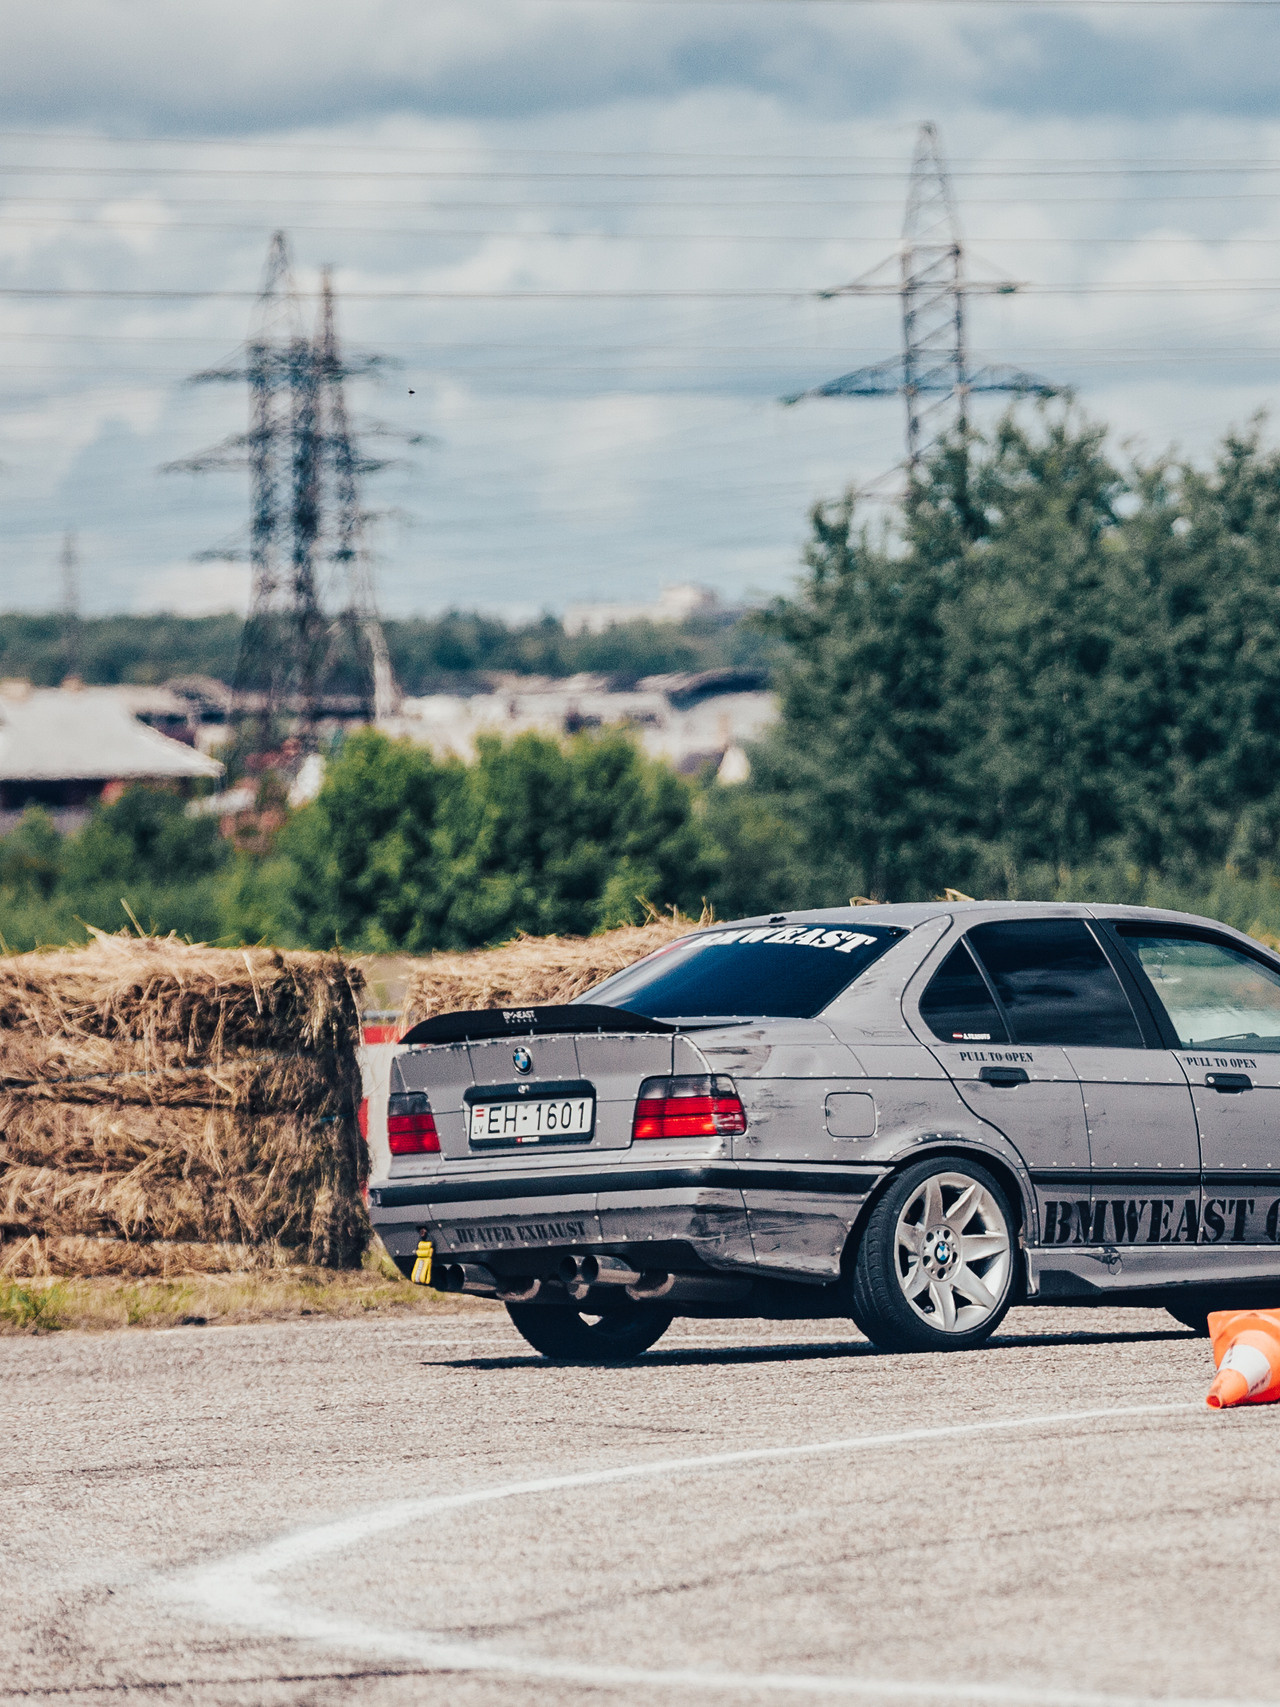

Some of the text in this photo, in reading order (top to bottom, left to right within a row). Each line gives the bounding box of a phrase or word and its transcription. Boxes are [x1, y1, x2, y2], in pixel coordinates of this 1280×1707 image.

[960, 1052, 1033, 1062] PULL TO OPEN
[1186, 1057, 1257, 1068] PULL TO OPEN
[474, 1125, 484, 1134] LV
[1042, 1198, 1256, 1244] BMWEAST
[516, 1221, 586, 1240] EXHAUST
